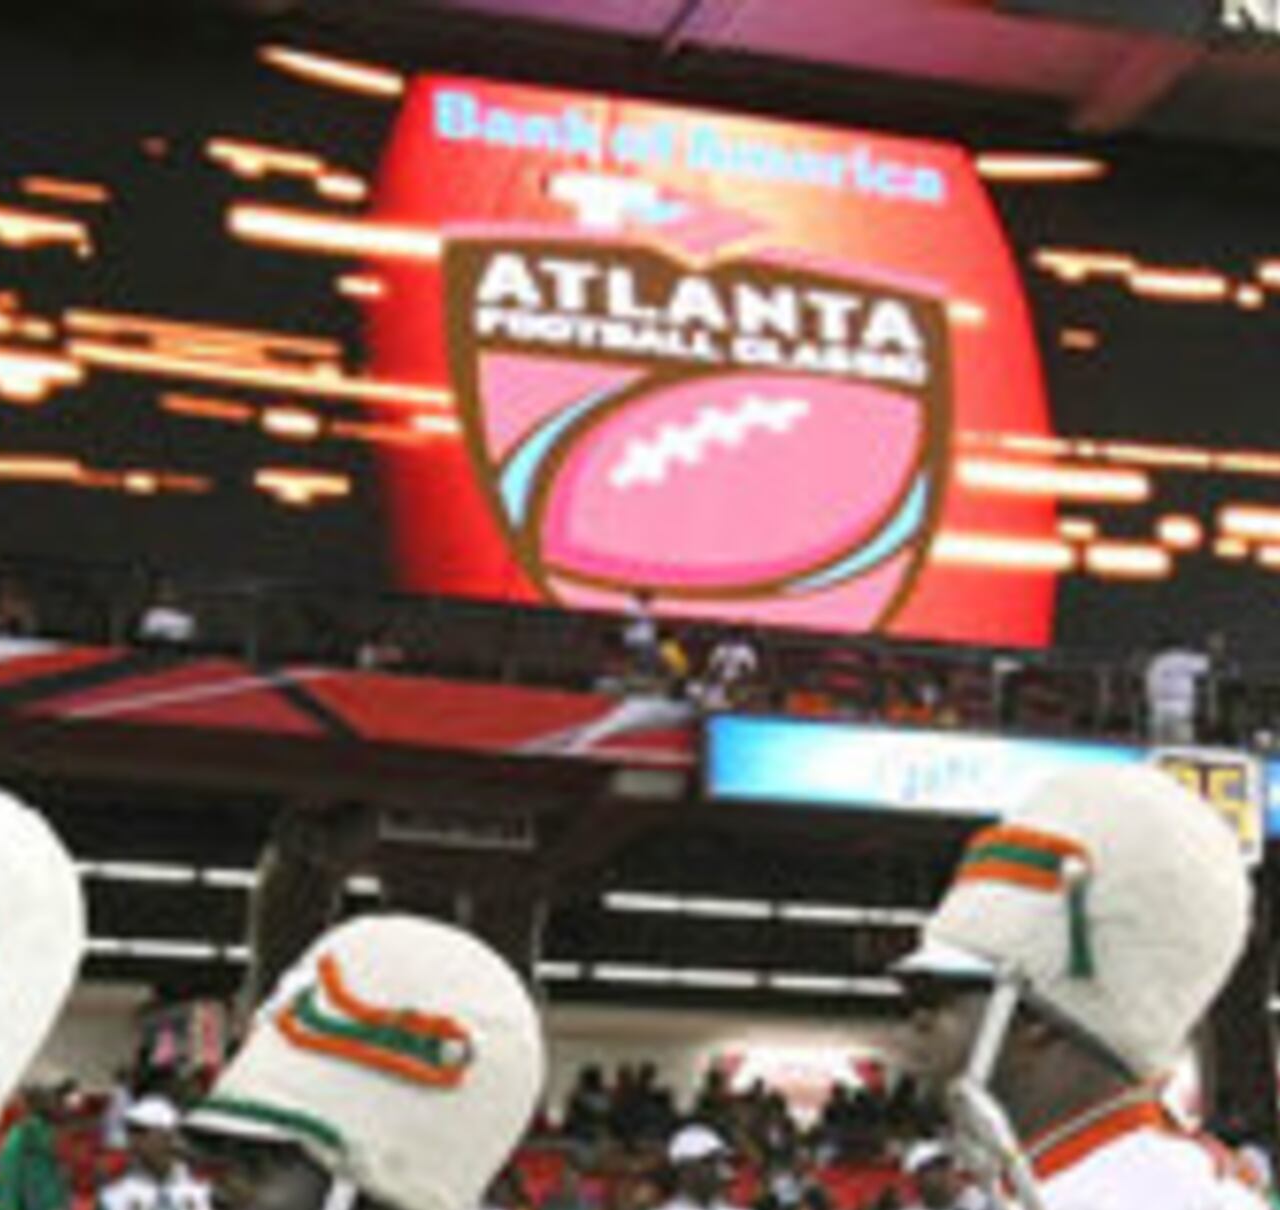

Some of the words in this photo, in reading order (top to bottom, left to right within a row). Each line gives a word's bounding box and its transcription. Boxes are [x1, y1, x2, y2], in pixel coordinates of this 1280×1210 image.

[435, 92, 603, 154] Bank
[612, 122, 677, 169] of
[688, 127, 945, 201] America
[475, 304, 720, 360] FOOTBALL
[476, 252, 924, 352] ATLANTA
